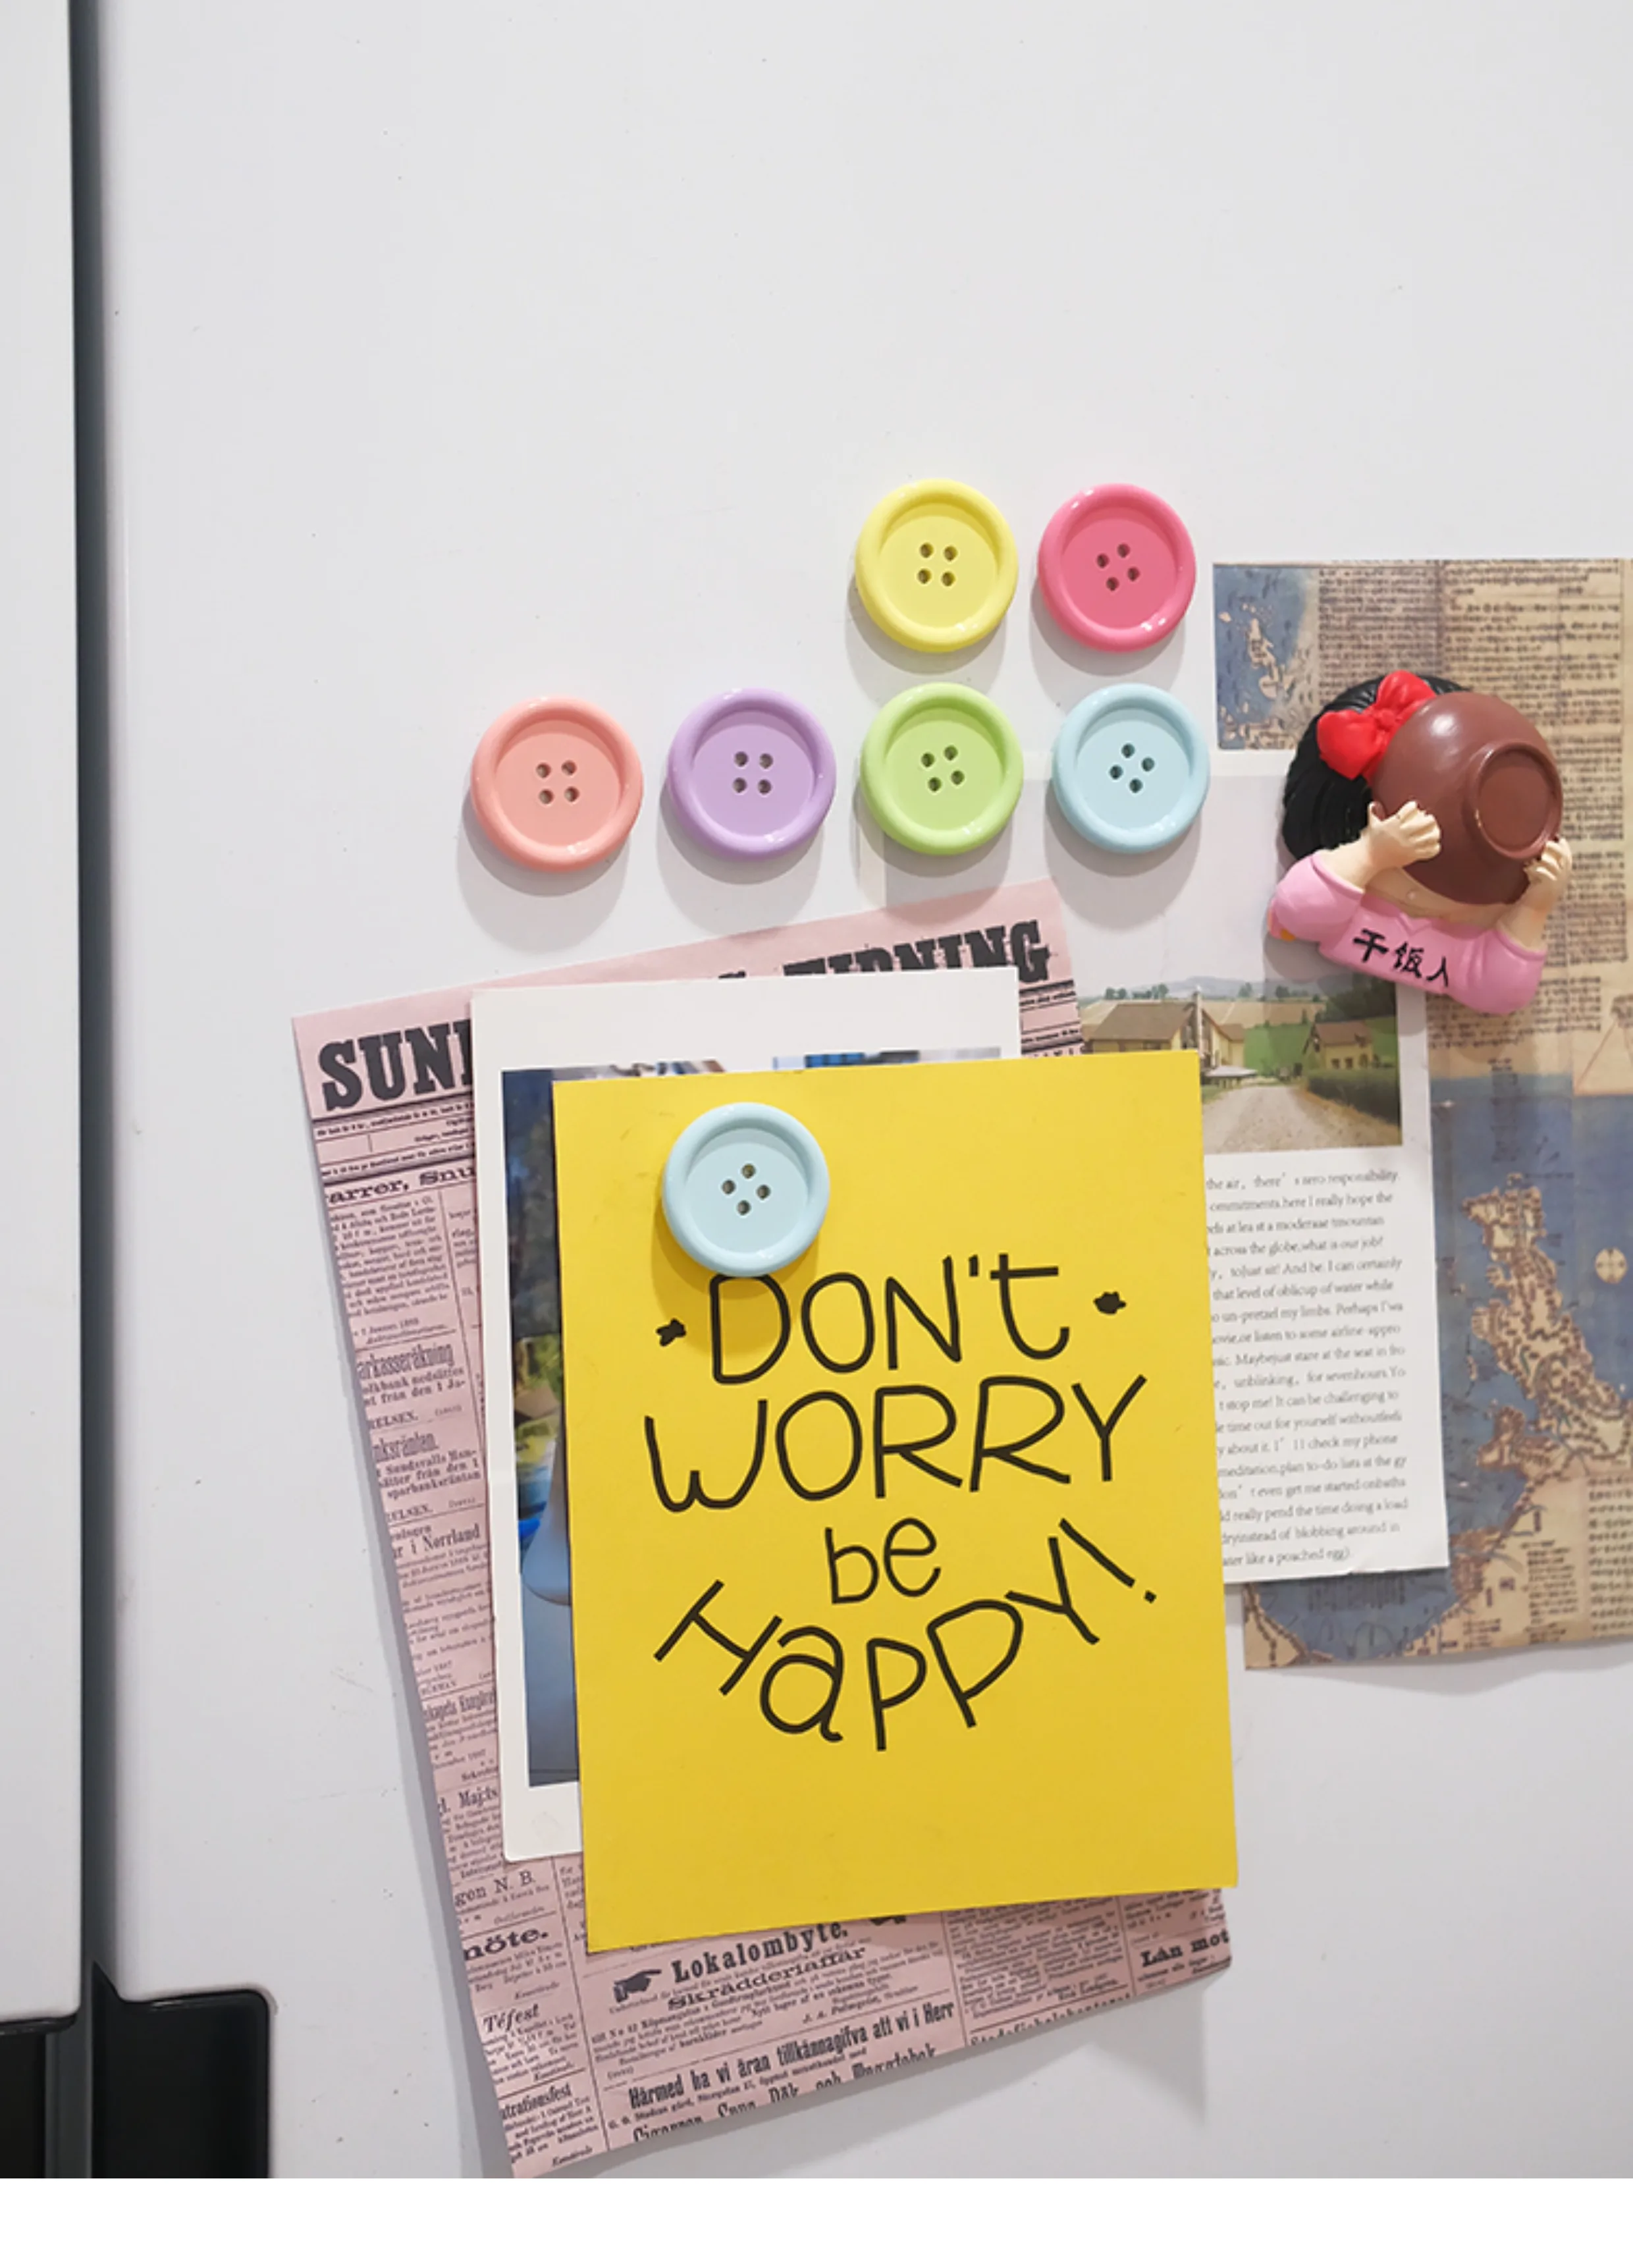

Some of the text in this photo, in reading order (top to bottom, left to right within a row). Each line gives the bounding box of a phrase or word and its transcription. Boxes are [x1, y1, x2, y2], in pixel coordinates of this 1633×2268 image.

[783, 919, 1050, 983] NING
[1353, 928, 1449, 987] 干饭人
[1308, 1195, 1314, 1207] I
[1347, 1195, 1374, 1207] hope
[1376, 1191, 1393, 1203] the
[1249, 1241, 1266, 1255] the
[1282, 1262, 1307, 1274] And
[1334, 1262, 1354, 1272] can
[1236, 1286, 1261, 1299] level
[1262, 1285, 1276, 1298] of
[1320, 1282, 1333, 1294] of
[1334, 1283, 1363, 1293] water
[1366, 1278, 1393, 1291] while
[1280, 1309, 1298, 1321] my
[1336, 1302, 1379, 1316] Perhaps
[1284, 1331, 1297, 1340] to
[1299, 1330, 1328, 1339] some
[1334, 1348, 1351, 1359] the
[1307, 1372, 1323, 1382] for
[1226, 1400, 1250, 1413] stop
[1275, 1395, 1283, 1406] It
[1287, 1397, 1305, 1406] can
[1308, 1394, 1321, 1404] be
[1324, 1391, 1385, 1405] challenging
[1387, 1391, 1399, 1400] to
[1227, 1415, 1336, 1432] time out for yourself
[644, 1374, 1148, 1513] WORRY
[1227, 1444, 1259, 1455] about
[1308, 1437, 1339, 1449] check
[1343, 1438, 1361, 1448] my
[1363, 1434, 1398, 1449] phone
[1363, 1458, 1372, 1467] at
[1374, 1455, 1391, 1467] the
[1257, 1487, 1283, 1497] even
[1286, 1485, 1302, 1498] get
[1233, 1508, 1263, 1522] really
[1295, 1505, 1313, 1517] the
[1315, 1505, 1339, 1515] time
[1341, 1501, 1374, 1514] doing
[422, 1523, 480, 1553] Norrland
[1278, 1528, 1291, 1540] of
[1347, 1522, 1386, 1535] around
[824, 1517, 942, 1605] be
[1246, 1553, 1266, 1565] like
[464, 1928, 549, 1960] nöte.
[1191, 1928, 1230, 1953] mot
[671, 1922, 849, 1984] Lokalombyte.
[690, 2069, 710, 2091] ha
[716, 2062, 731, 2084] vi
[896, 2010, 910, 2032] vi
[913, 2008, 920, 2028] i
[923, 2001, 955, 2025] Herr
